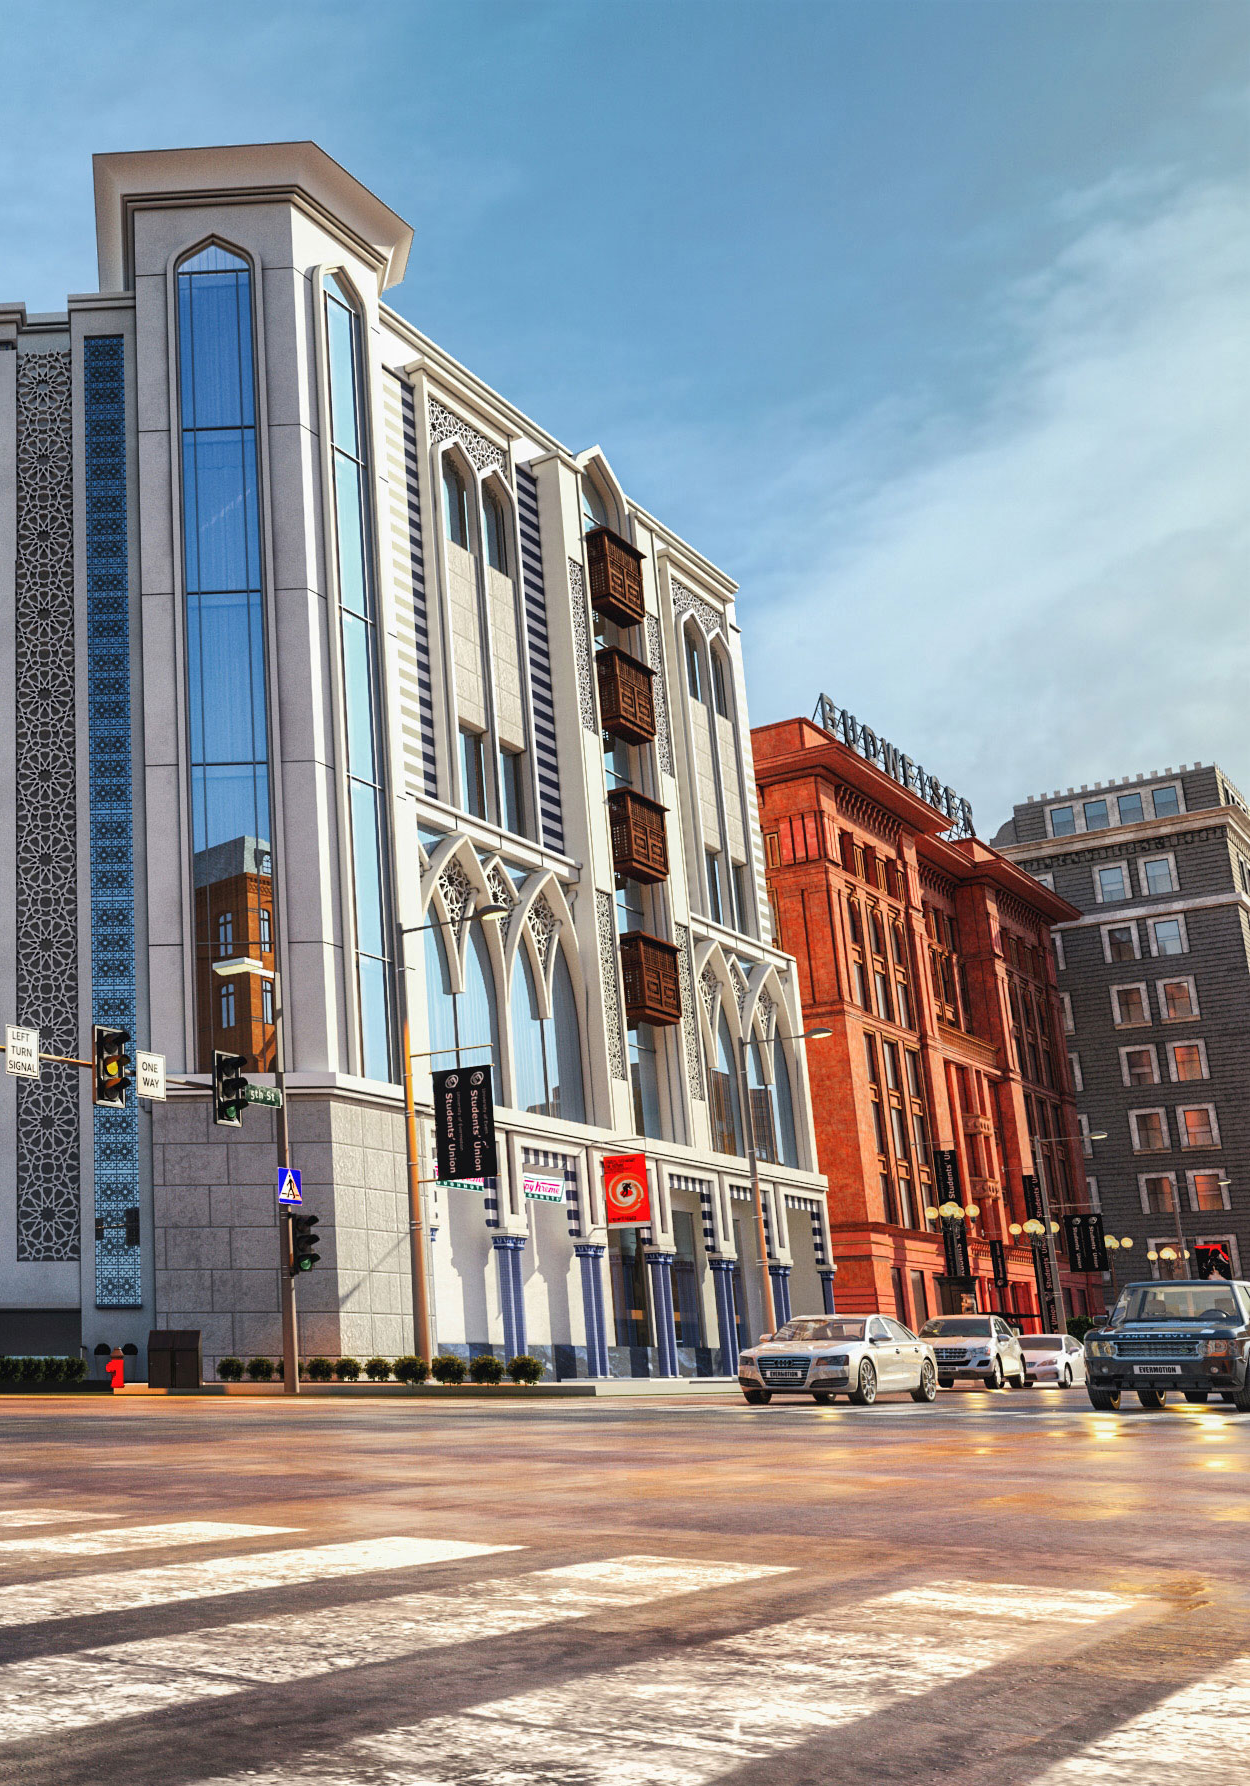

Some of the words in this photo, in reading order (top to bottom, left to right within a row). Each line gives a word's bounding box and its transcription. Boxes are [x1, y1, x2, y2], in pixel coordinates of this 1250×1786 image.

[820, 693, 977, 836] BUDWEISER
[12, 1031, 30, 1042] LEFT
[11, 1045, 32, 1057] TURN
[8, 1060, 36, 1073] SIGNAL
[141, 1061, 158, 1073] ONE
[142, 1076, 159, 1088] WAY
[250, 1089, 263, 1100] 5th
[266, 1091, 275, 1101] St
[445, 1092, 455, 1141] Students'
[470, 1089, 481, 1138] Students'
[448, 1144, 457, 1173] Union
[473, 1141, 482, 1171] Union
[1138, 1366, 1176, 1374] EVERMOTION
